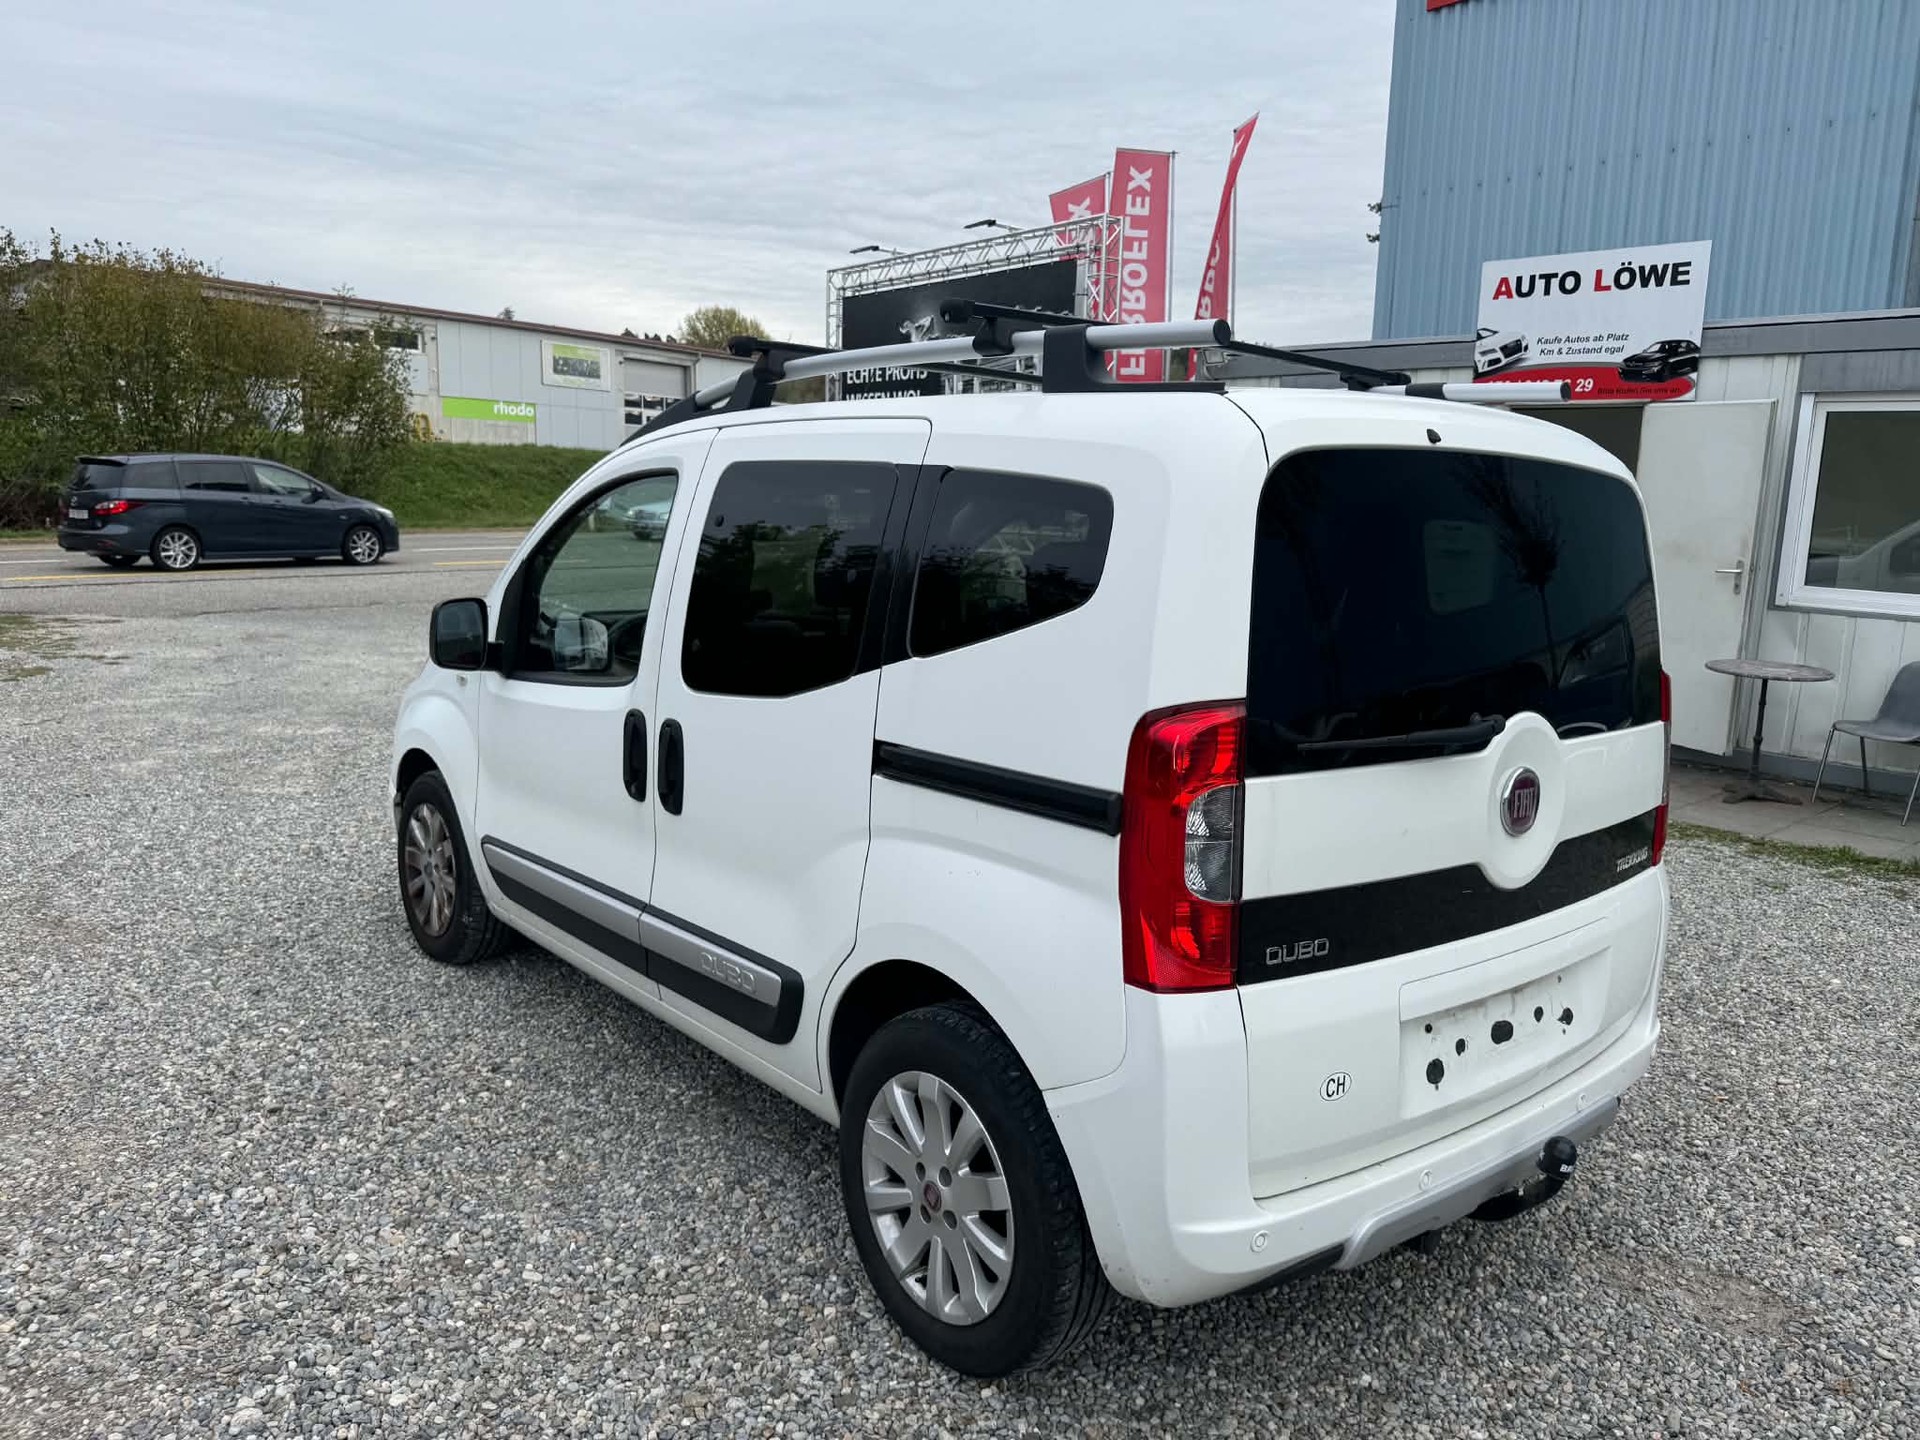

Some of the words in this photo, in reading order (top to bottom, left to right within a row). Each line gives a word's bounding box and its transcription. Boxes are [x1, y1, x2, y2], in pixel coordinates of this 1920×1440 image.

[1492, 270, 1581, 300] AUTO
[1593, 261, 1692, 292] LÖWE
[1537, 336, 1562, 345] Kaufe
[1564, 335, 1590, 344] Autos
[1592, 334, 1604, 342] ab
[1607, 333, 1630, 342] Platz
[1539, 348, 1554, 356] Km
[1565, 345, 1602, 355] Zustand
[1604, 344, 1625, 355] egal
[1575, 378, 1594, 392] 29
[493, 401, 535, 418] rhodo
[1513, 787, 1536, 818] FIAT
[1266, 938, 1329, 965] QUBO
[1326, 1075, 1346, 1097] CH
